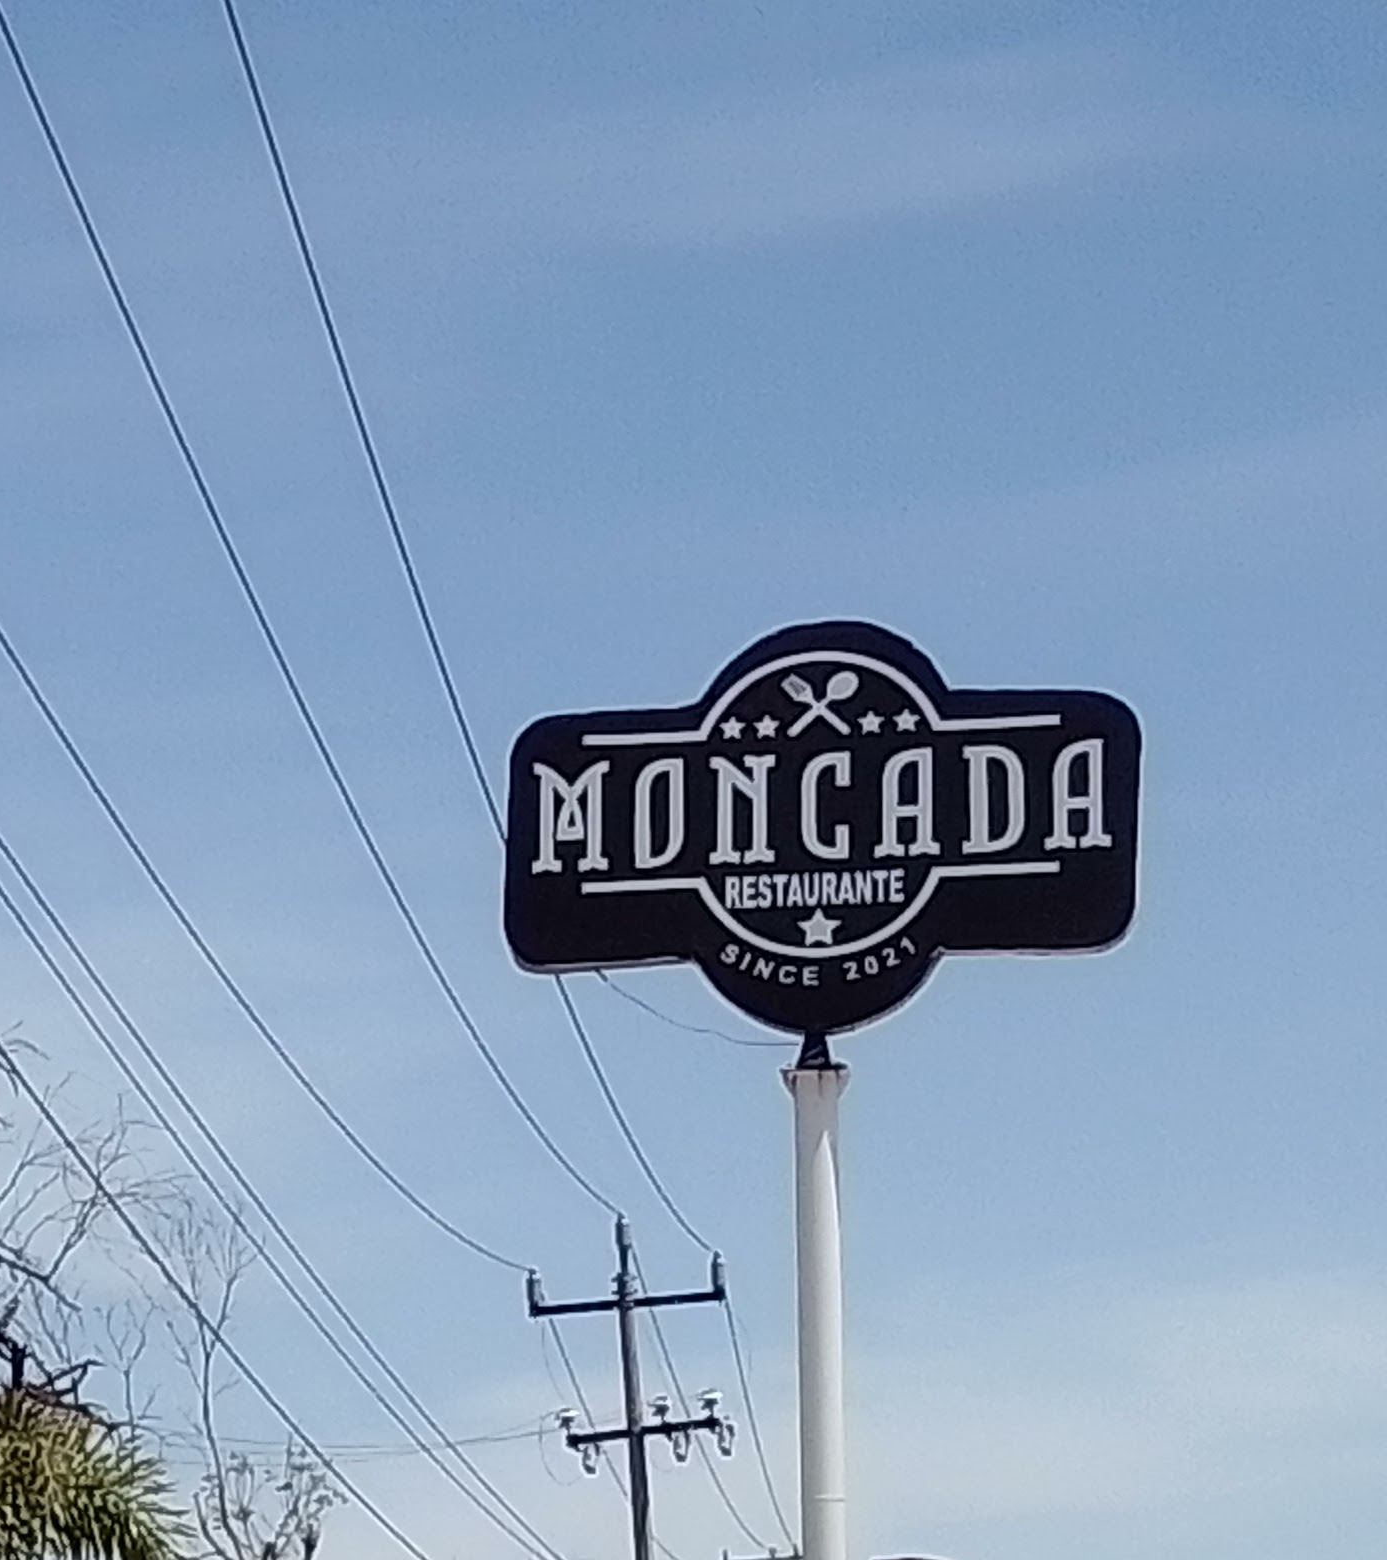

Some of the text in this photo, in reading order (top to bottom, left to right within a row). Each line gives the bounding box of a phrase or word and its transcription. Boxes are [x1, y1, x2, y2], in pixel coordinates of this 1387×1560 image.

[531, 738, 1112, 874] MONCADA
[724, 868, 906, 909] RESTAURANTE
[720, 936, 916, 986] SINCE 2021
